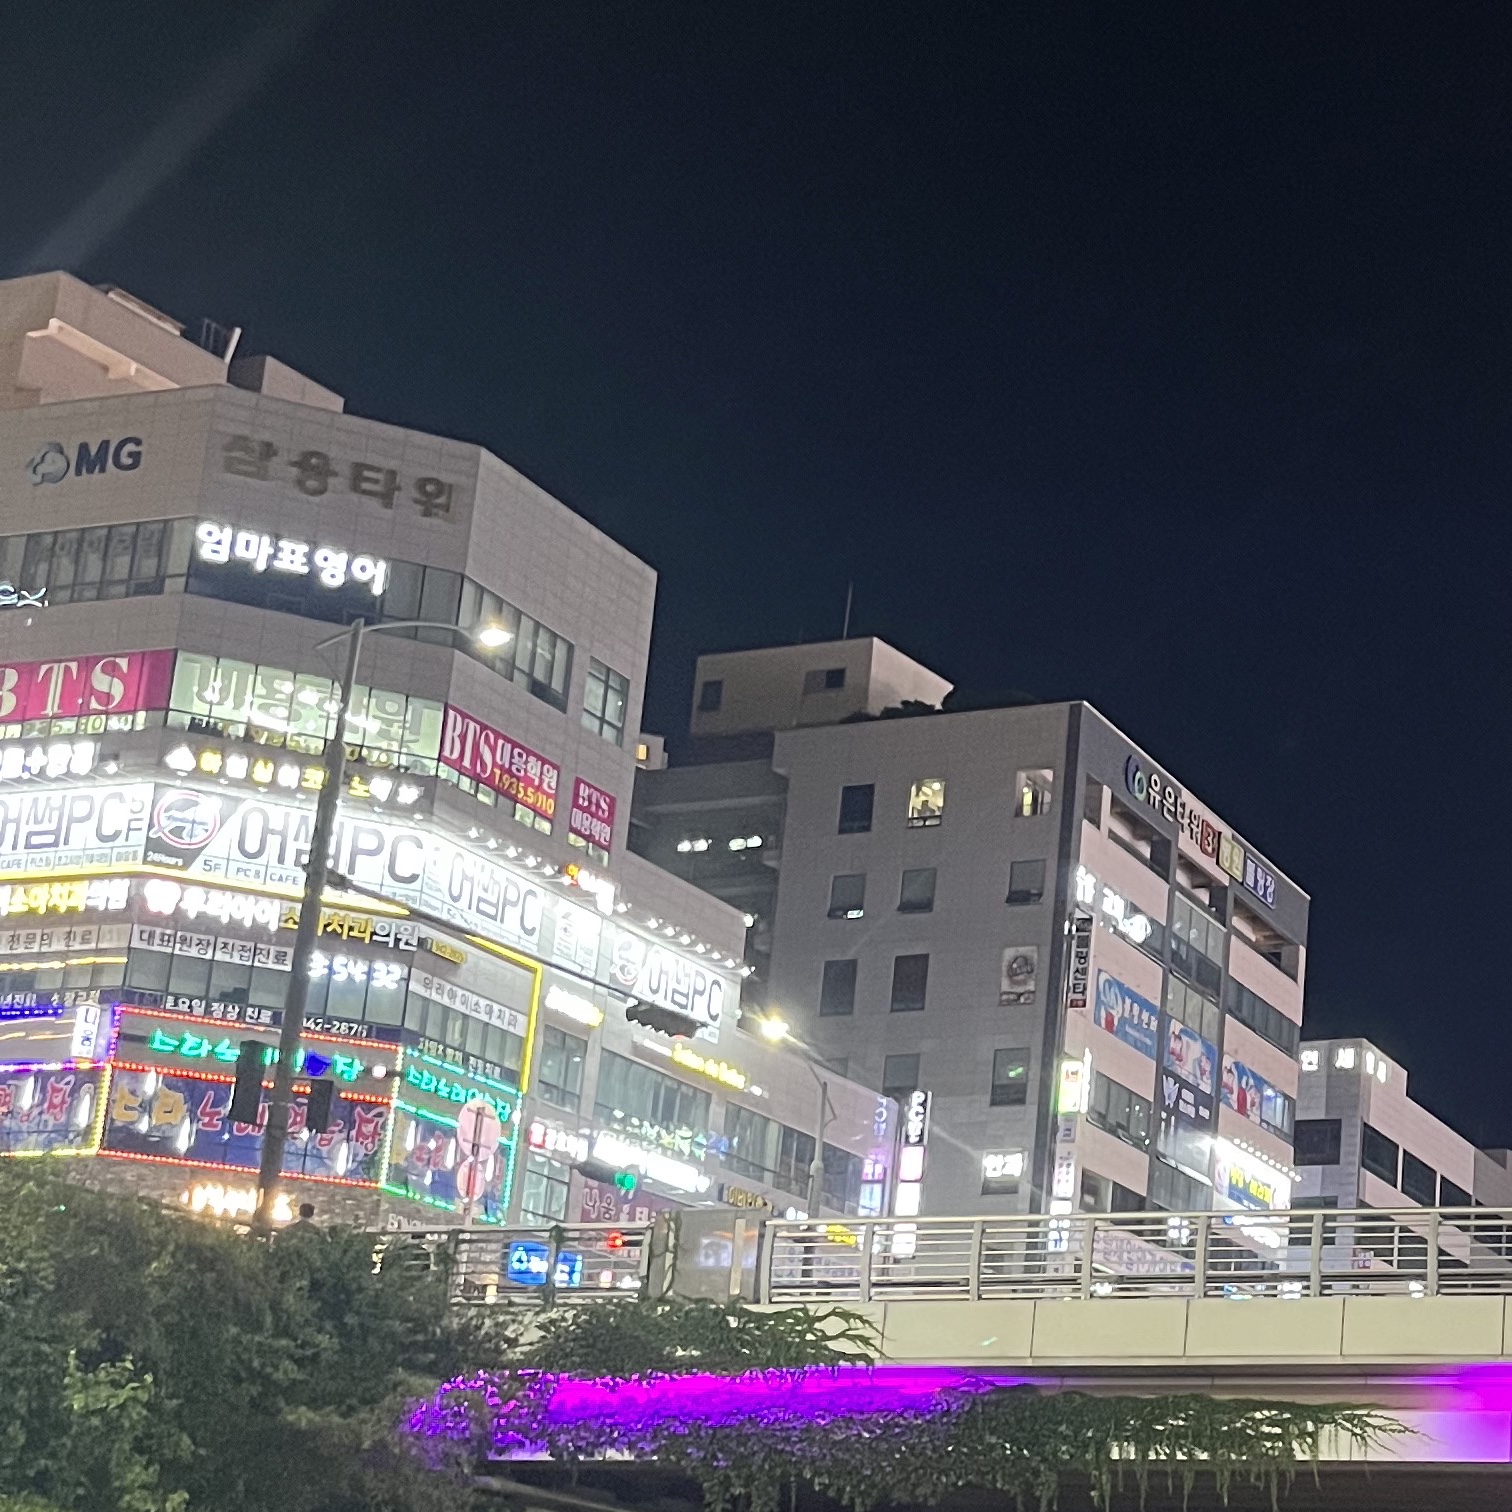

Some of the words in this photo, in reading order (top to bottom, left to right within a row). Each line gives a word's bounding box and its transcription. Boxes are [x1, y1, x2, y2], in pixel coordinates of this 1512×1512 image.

[75, 437, 143, 477] MG
[196, 521, 387, 595] 엄마표영어
[442, 709, 494, 778] BTS
[496, 739, 557, 794] 미용학원
[578, 782, 609, 818] BTS
[1148, 773, 1200, 846] 유은타워
[269, 872, 299, 886] CAFE
[211, 1002, 240, 1021] 정상
